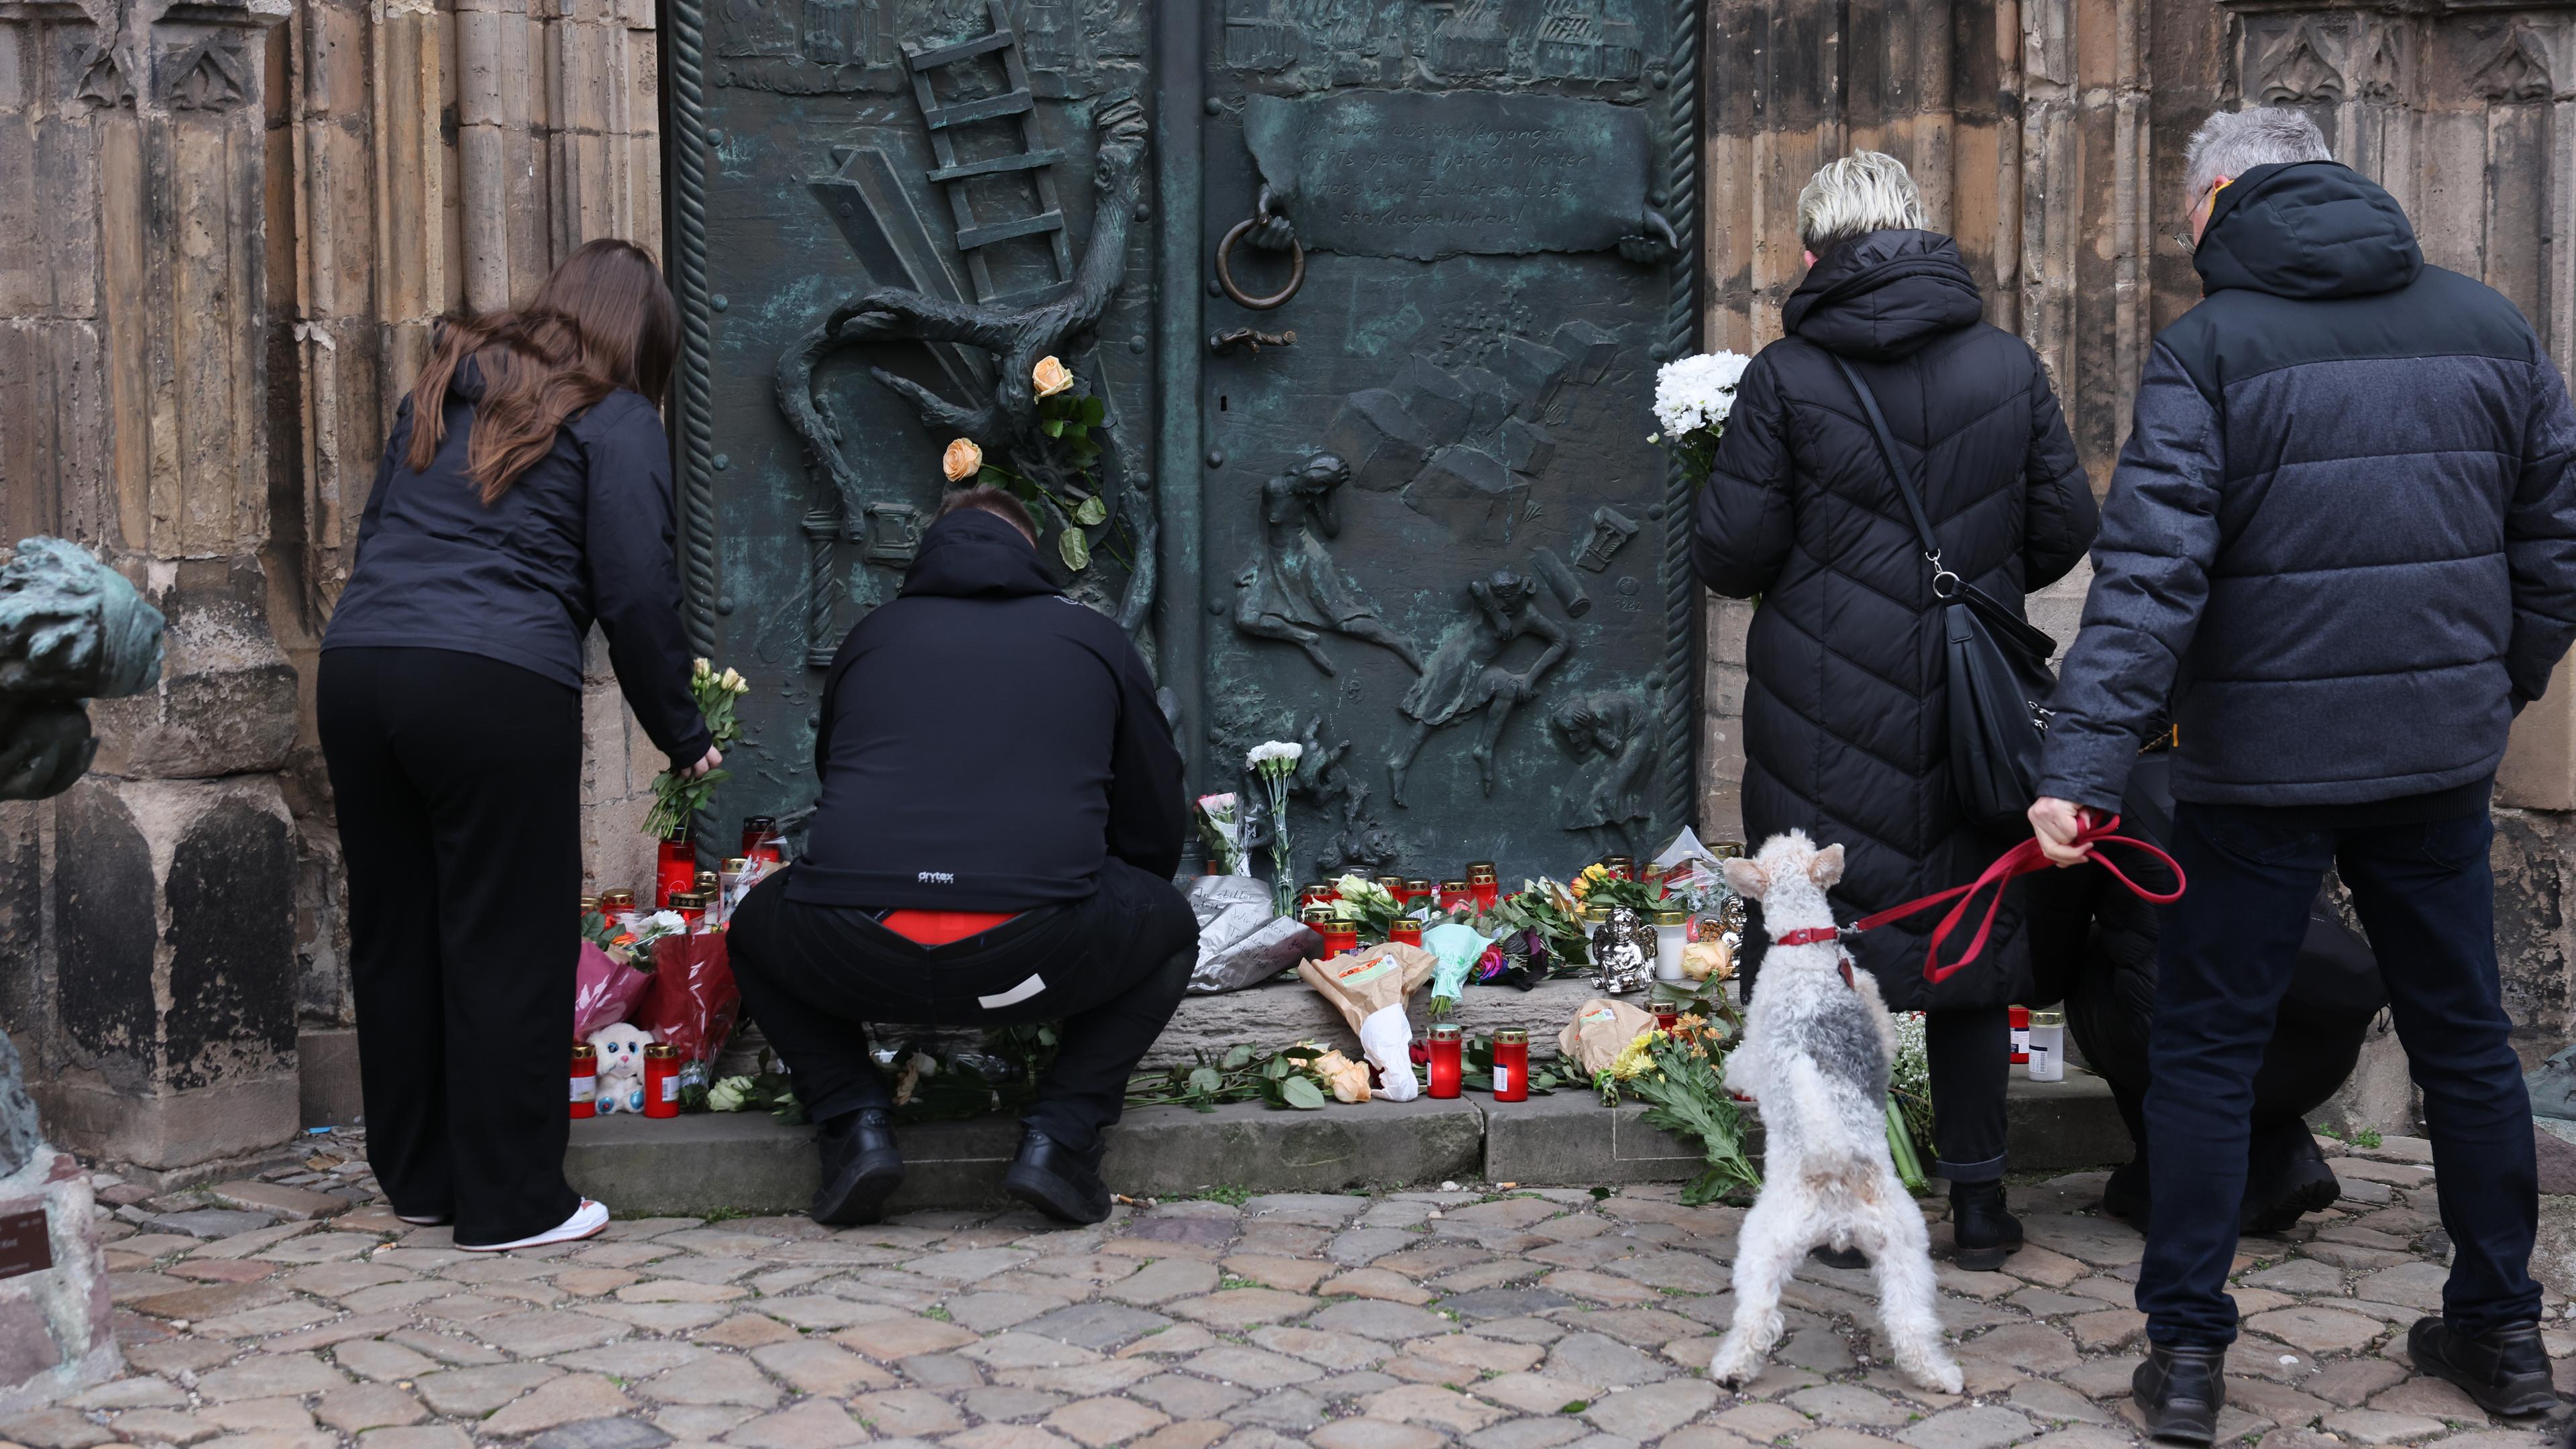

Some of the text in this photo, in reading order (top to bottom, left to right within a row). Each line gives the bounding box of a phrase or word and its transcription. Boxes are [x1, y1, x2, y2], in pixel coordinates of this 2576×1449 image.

[1336, 118, 1385, 136] aber
[1433, 123, 1462, 139] der
[1365, 149, 1436, 172] gelernt
[1442, 145, 1474, 174] hat
[1316, 172, 1363, 197] Hass
[1417, 176, 1532, 199] Zwietracht
[1341, 209, 1373, 226] den
[918, 871, 954, 880] drytex
[1218, 889, 1254, 901] stiller
[1234, 907, 1250, 924] Wir
[1228, 924, 1270, 957] Truern
